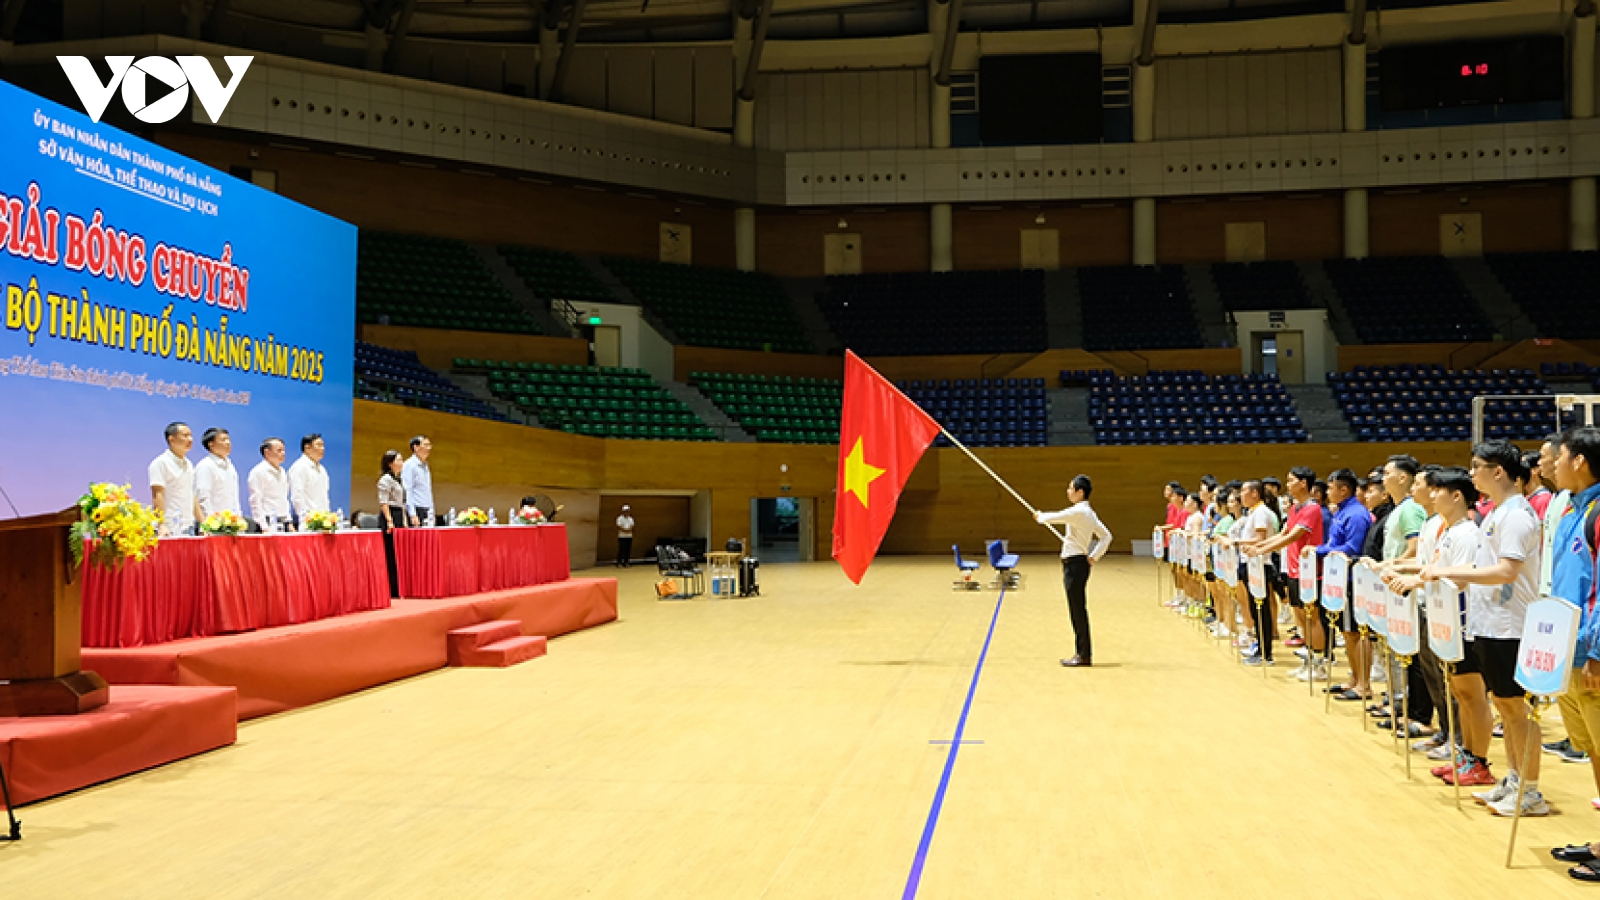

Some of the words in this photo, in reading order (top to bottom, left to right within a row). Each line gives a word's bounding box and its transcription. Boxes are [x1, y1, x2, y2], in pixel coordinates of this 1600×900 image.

[52, 119, 75, 140] BAN
[77, 128, 108, 153] NHÂN
[109, 142, 131, 162] DÂN
[59, 146, 84, 168] VĂN
[138, 176, 166, 198] THAO
[64, 208, 147, 287] BÓNG
[152, 241, 249, 313] CHUYỀN
[6, 275, 42, 346] BỘ
[47, 287, 126, 351] THÀNH
[130, 302, 174, 359] PHỐ
[175, 313, 201, 364] ĐÀ
[203, 315, 251, 372] NẴNG
[253, 333, 289, 379] NĂM
[290, 345, 324, 385] 2025
